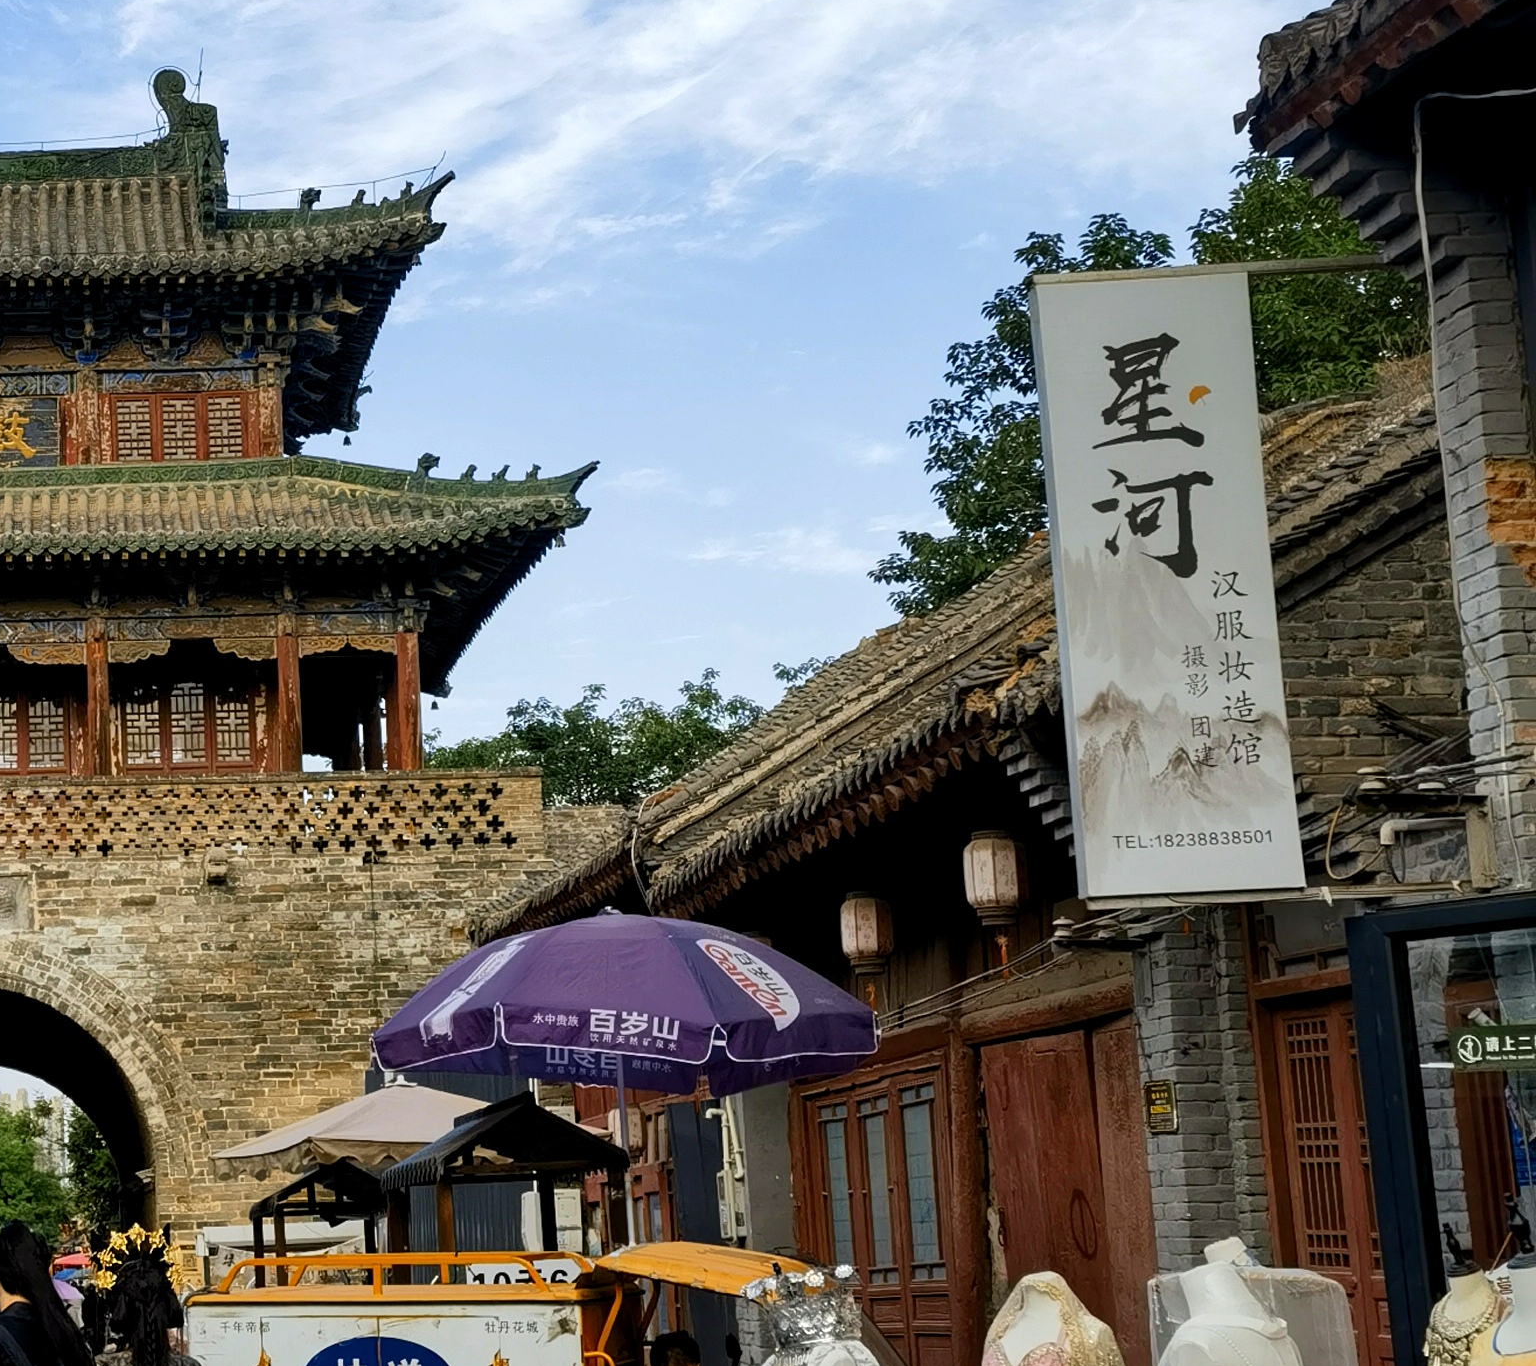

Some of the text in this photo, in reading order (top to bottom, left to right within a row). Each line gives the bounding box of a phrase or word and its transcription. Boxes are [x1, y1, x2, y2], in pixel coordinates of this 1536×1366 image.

[1092, 333, 1213, 579] 星河
[1210, 569, 1263, 768] 汉服妆造馆
[1181, 644, 1219, 769] 摄影 团建
[1113, 828, 1275, 850] TEL:18238838501
[733, 952, 789, 997] 百岁山
[532, 1008, 680, 1041] 水中贵族 百岁山
[589, 1033, 678, 1052] 饮用天然矿泉水
[1485, 1035, 1536, 1053] 请上二
[483, 1320, 540, 1335] 牡丹花城
